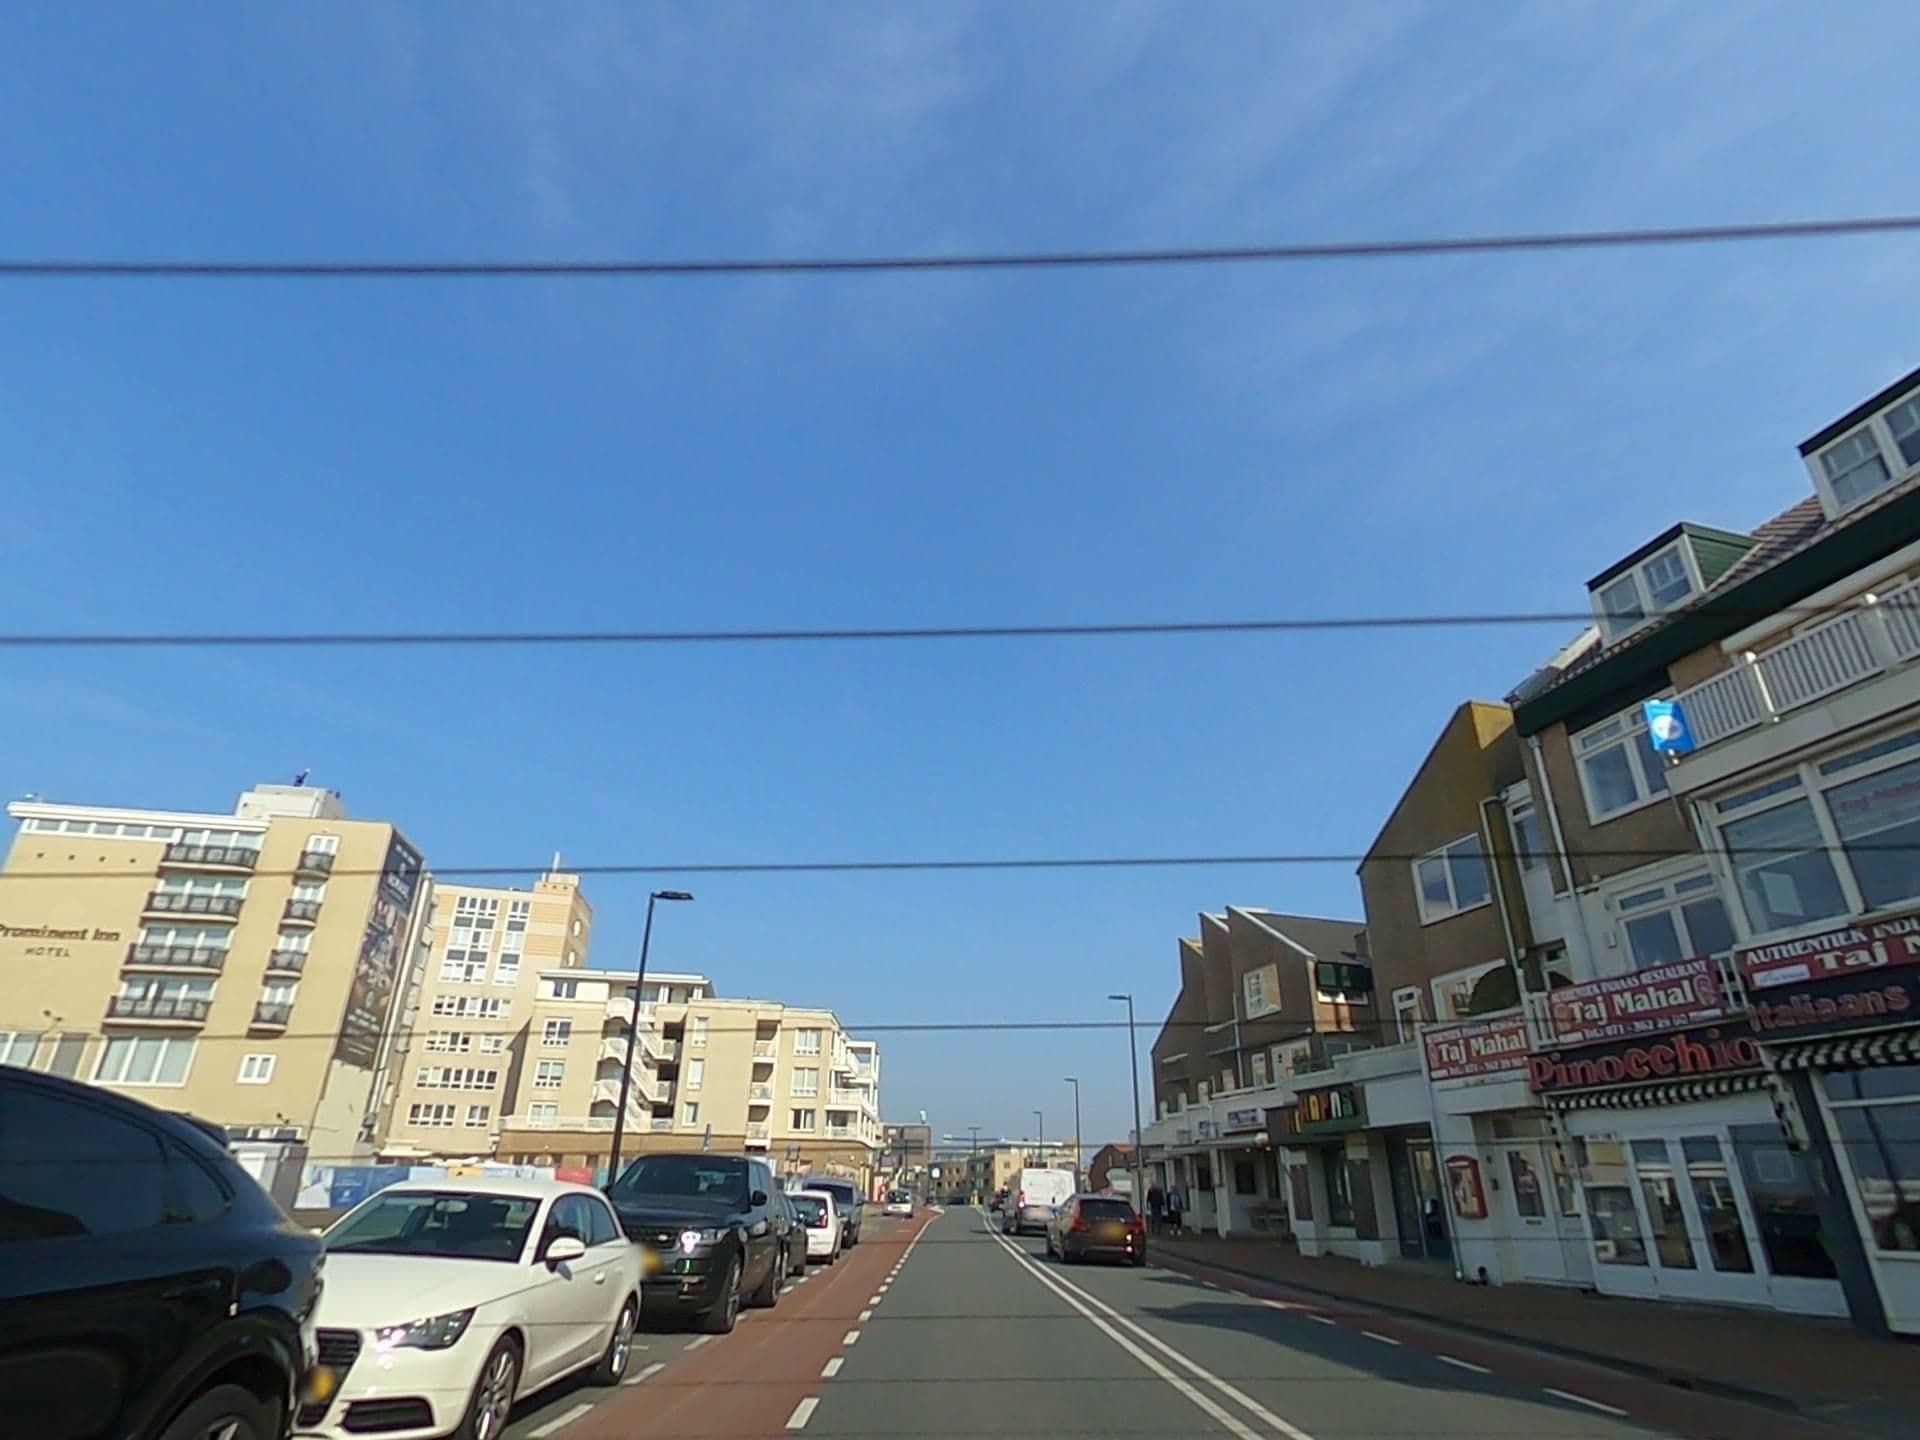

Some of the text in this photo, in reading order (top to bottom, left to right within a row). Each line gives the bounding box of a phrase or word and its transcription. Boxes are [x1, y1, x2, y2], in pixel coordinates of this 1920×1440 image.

[25, 946, 70, 957] HOTEL
[92, 928, 120, 941] Inn
[1747, 928, 1869, 965] AUTHENTIEK
[1815, 941, 1889, 970] Taj
[1568, 995, 1609, 1026] Taj
[1612, 980, 1695, 1016] Mahal
[1746, 985, 1911, 1032] Italiaans
[1438, 1039, 1467, 1064] Taj
[1469, 1029, 1527, 1057] Mahal
[1528, 1028, 1764, 1090] Pinocchio
